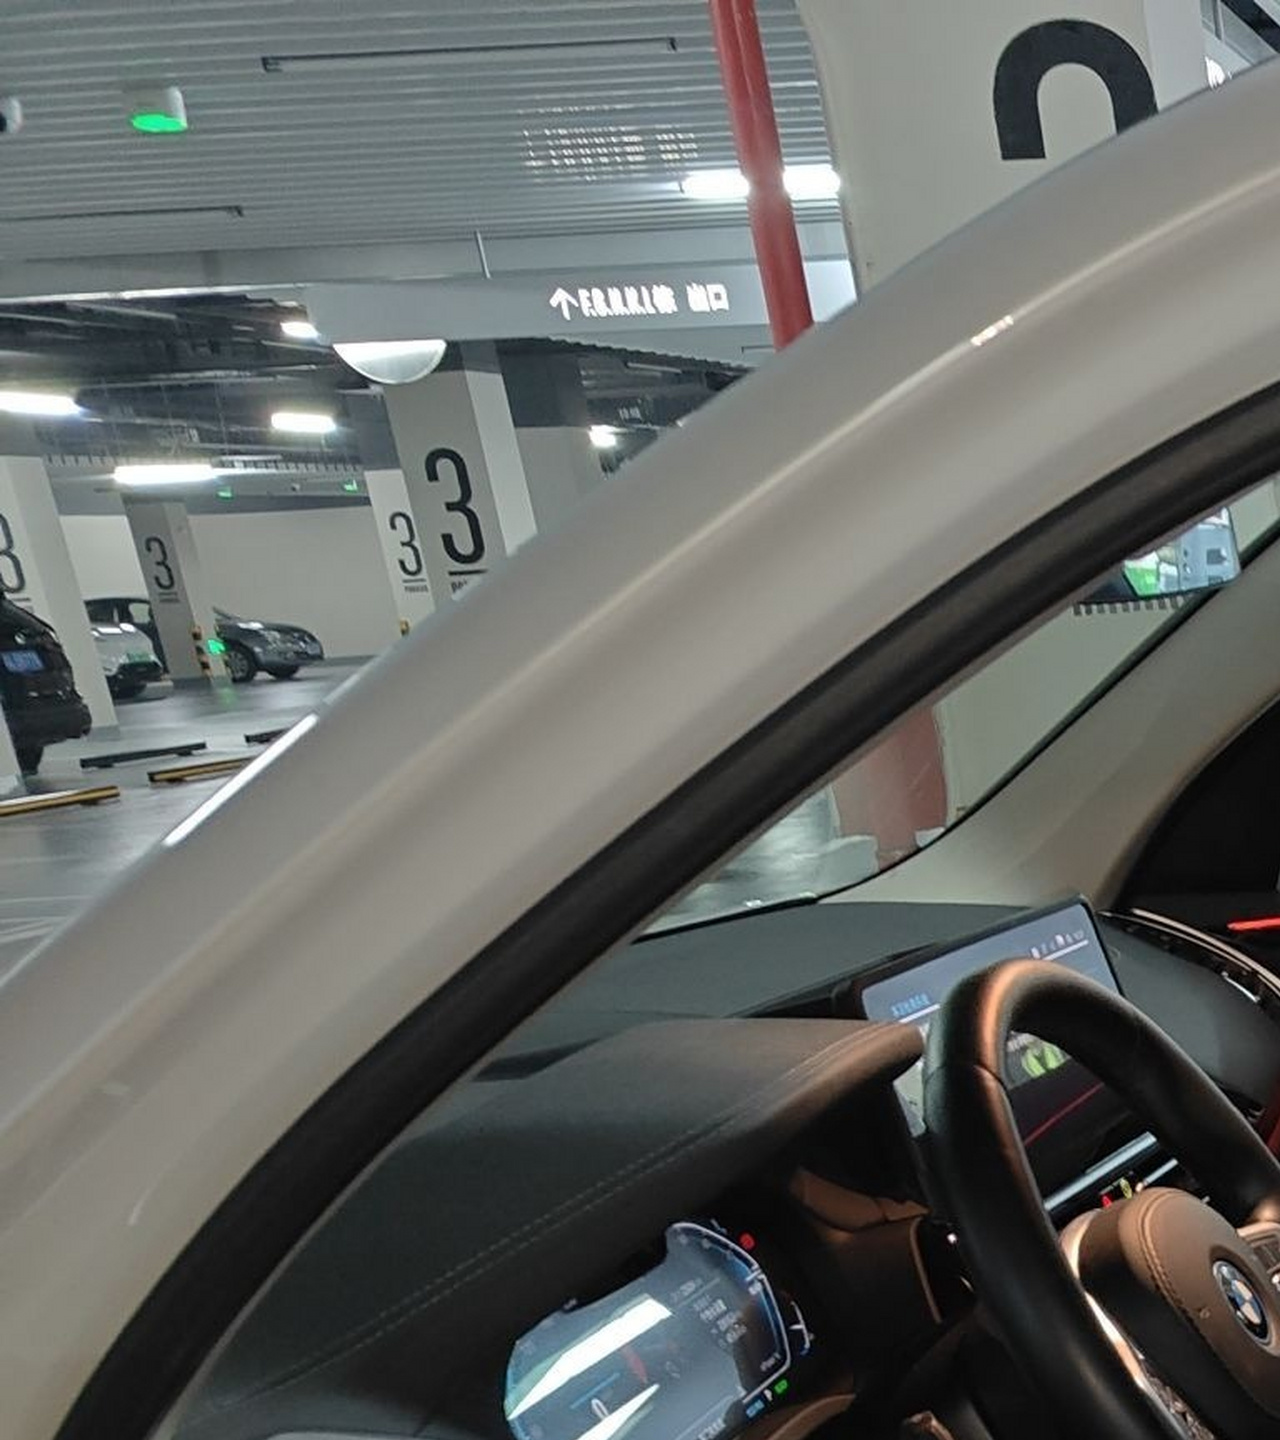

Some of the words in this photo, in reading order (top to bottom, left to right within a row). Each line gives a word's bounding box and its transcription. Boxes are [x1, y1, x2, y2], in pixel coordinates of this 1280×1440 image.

[425, 448, 485, 564] 3
[145, 536, 175, 590] 3
[389, 511, 423, 577] 3
